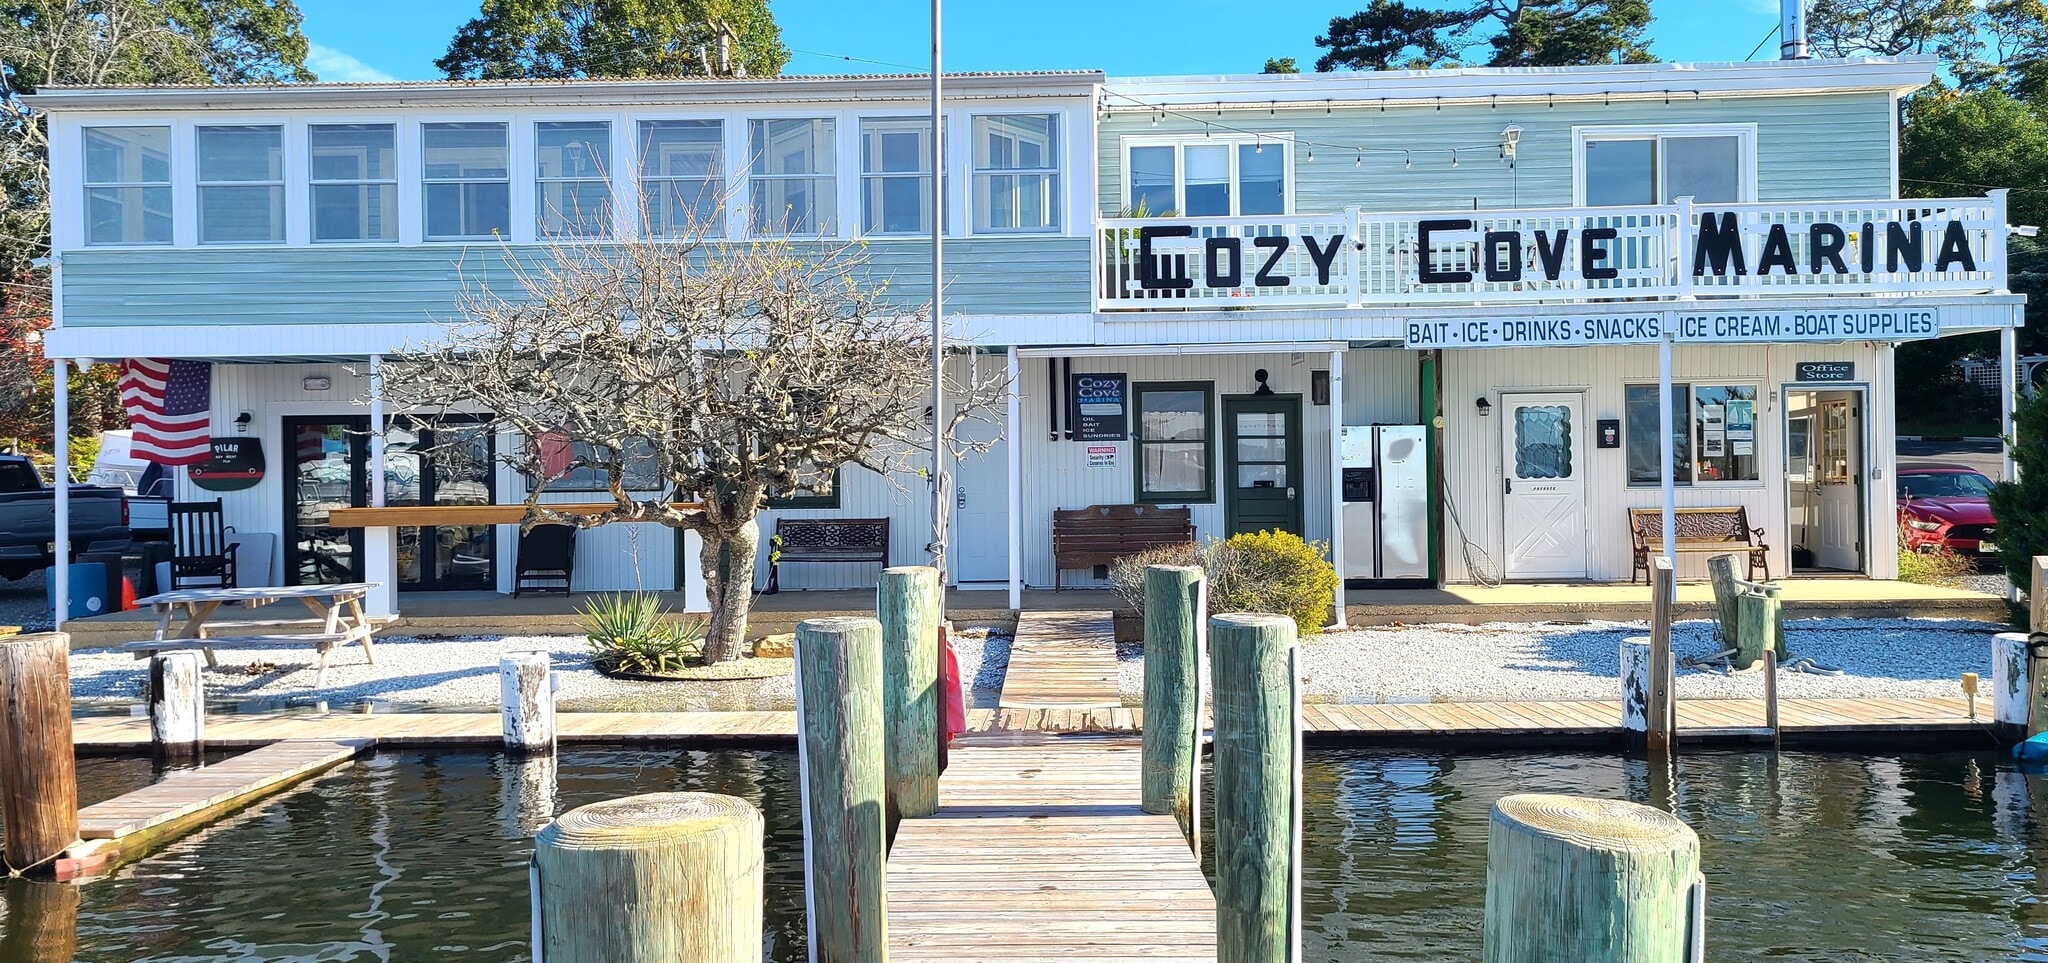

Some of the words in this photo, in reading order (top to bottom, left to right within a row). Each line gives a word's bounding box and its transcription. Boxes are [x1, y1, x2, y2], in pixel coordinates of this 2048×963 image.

[1140, 225, 1345, 289] COZY
[1418, 219, 1618, 284] COVE
[1693, 211, 1977, 277] MARINA
[1409, 322, 1449, 344] BAIT
[1462, 321, 1489, 343] ICE
[1502, 319, 1571, 342] DRINKS
[1584, 317, 1660, 340] SNACKS
[1679, 316, 1707, 338] ICE
[1714, 315, 1781, 337] CREAM
[1794, 314, 1838, 336] BOAT
[1842, 312, 1932, 335] SUPPLIES
[1801, 364, 1849, 372] Office
[1806, 371, 1844, 379] Store
[214, 443, 239, 454] PILAR
